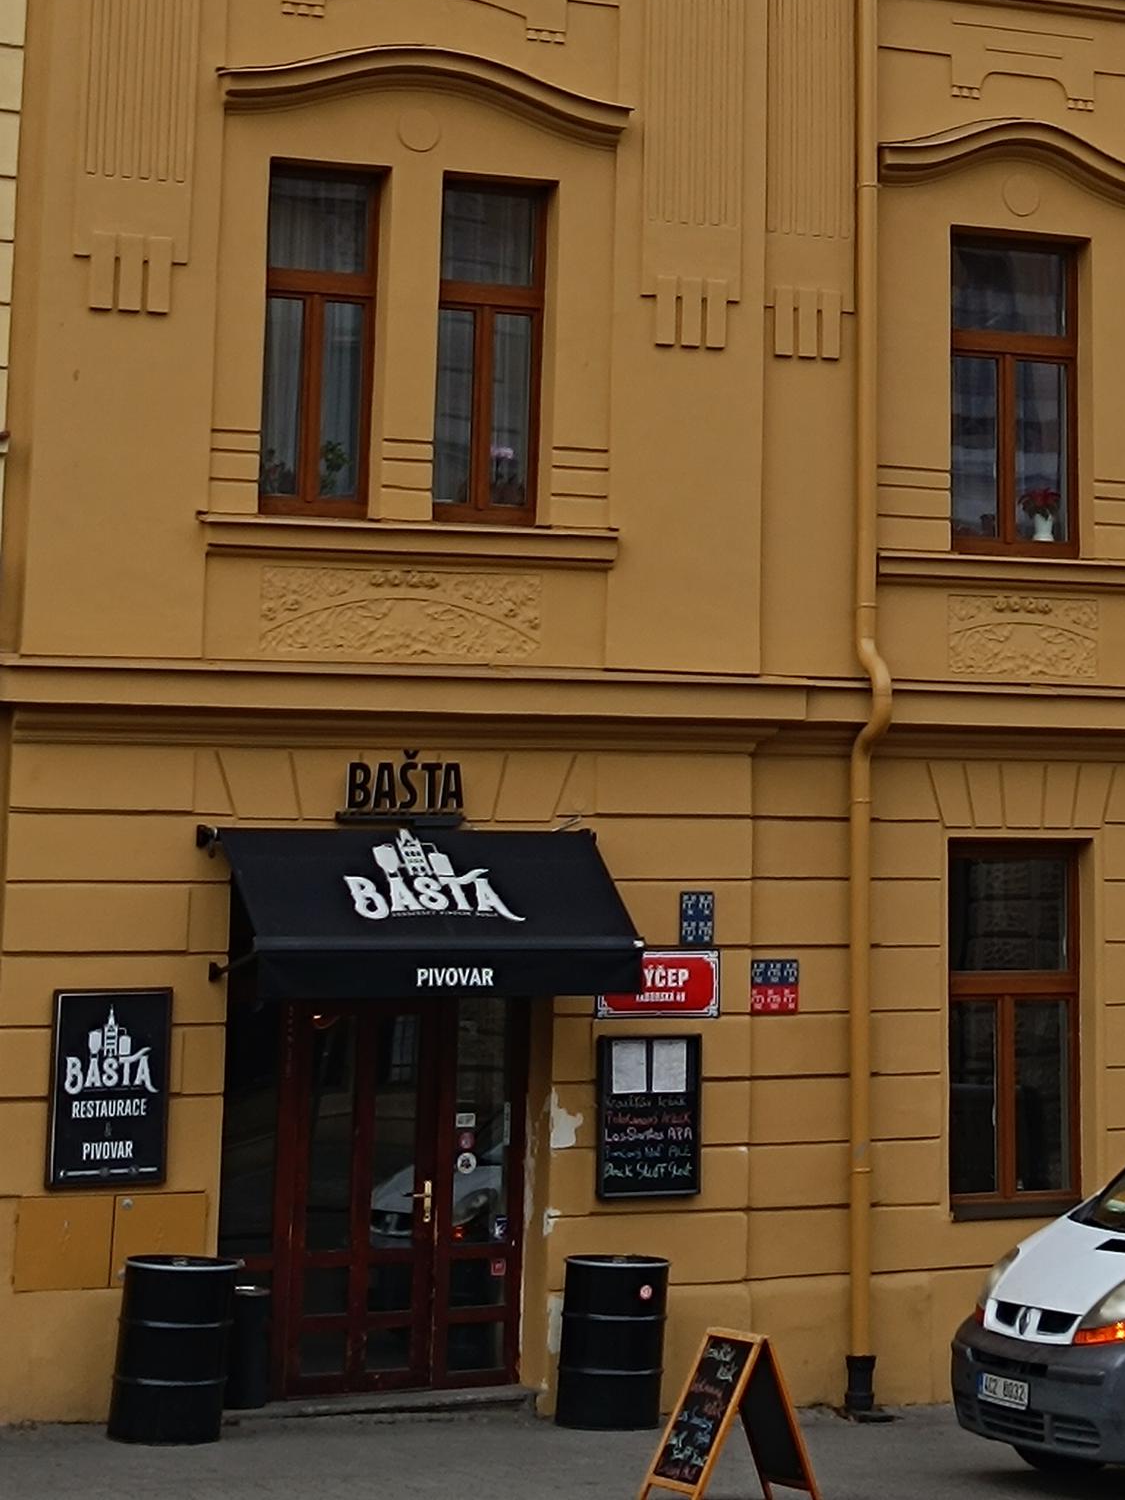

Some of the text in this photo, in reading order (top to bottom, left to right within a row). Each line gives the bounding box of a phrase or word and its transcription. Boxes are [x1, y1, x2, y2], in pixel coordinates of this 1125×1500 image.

[346, 750, 464, 810] BAŠTA
[416, 967, 494, 987] PIVOVAR
[644, 965, 689, 988] ÝČEP
[72, 1098, 148, 1118] RESTAURACE
[82, 1140, 134, 1160] PIVOVAR
